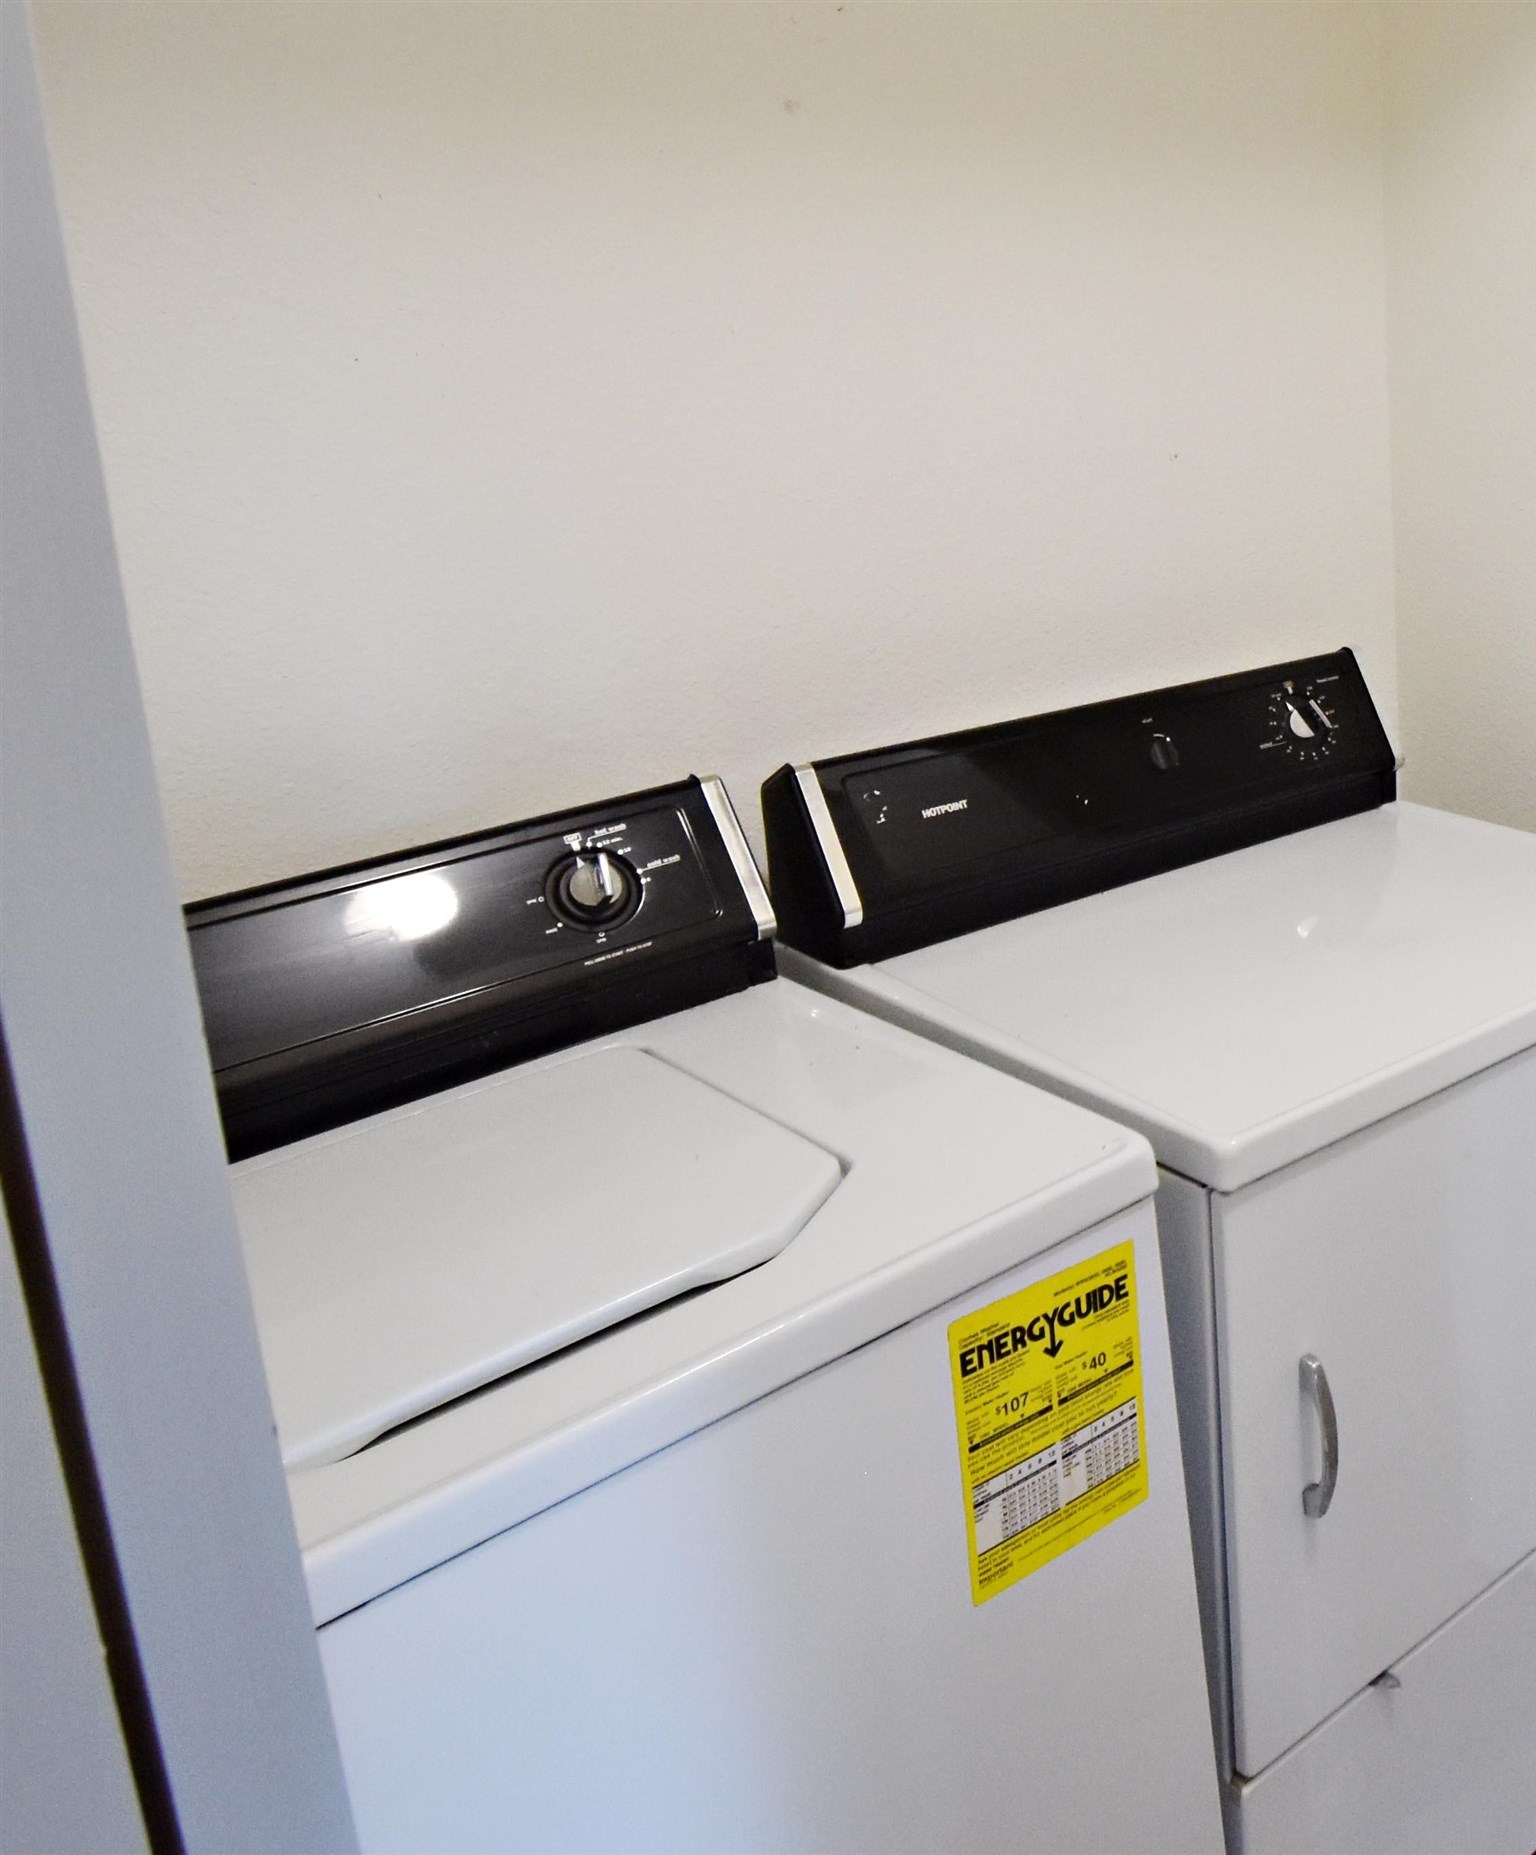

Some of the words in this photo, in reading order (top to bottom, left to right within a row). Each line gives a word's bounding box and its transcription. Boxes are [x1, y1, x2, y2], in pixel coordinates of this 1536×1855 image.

[922, 799, 968, 819] HOTPOINT
[959, 1273, 1129, 1378] ENERGYGUIDE
[995, 1391, 1029, 1416] $107
